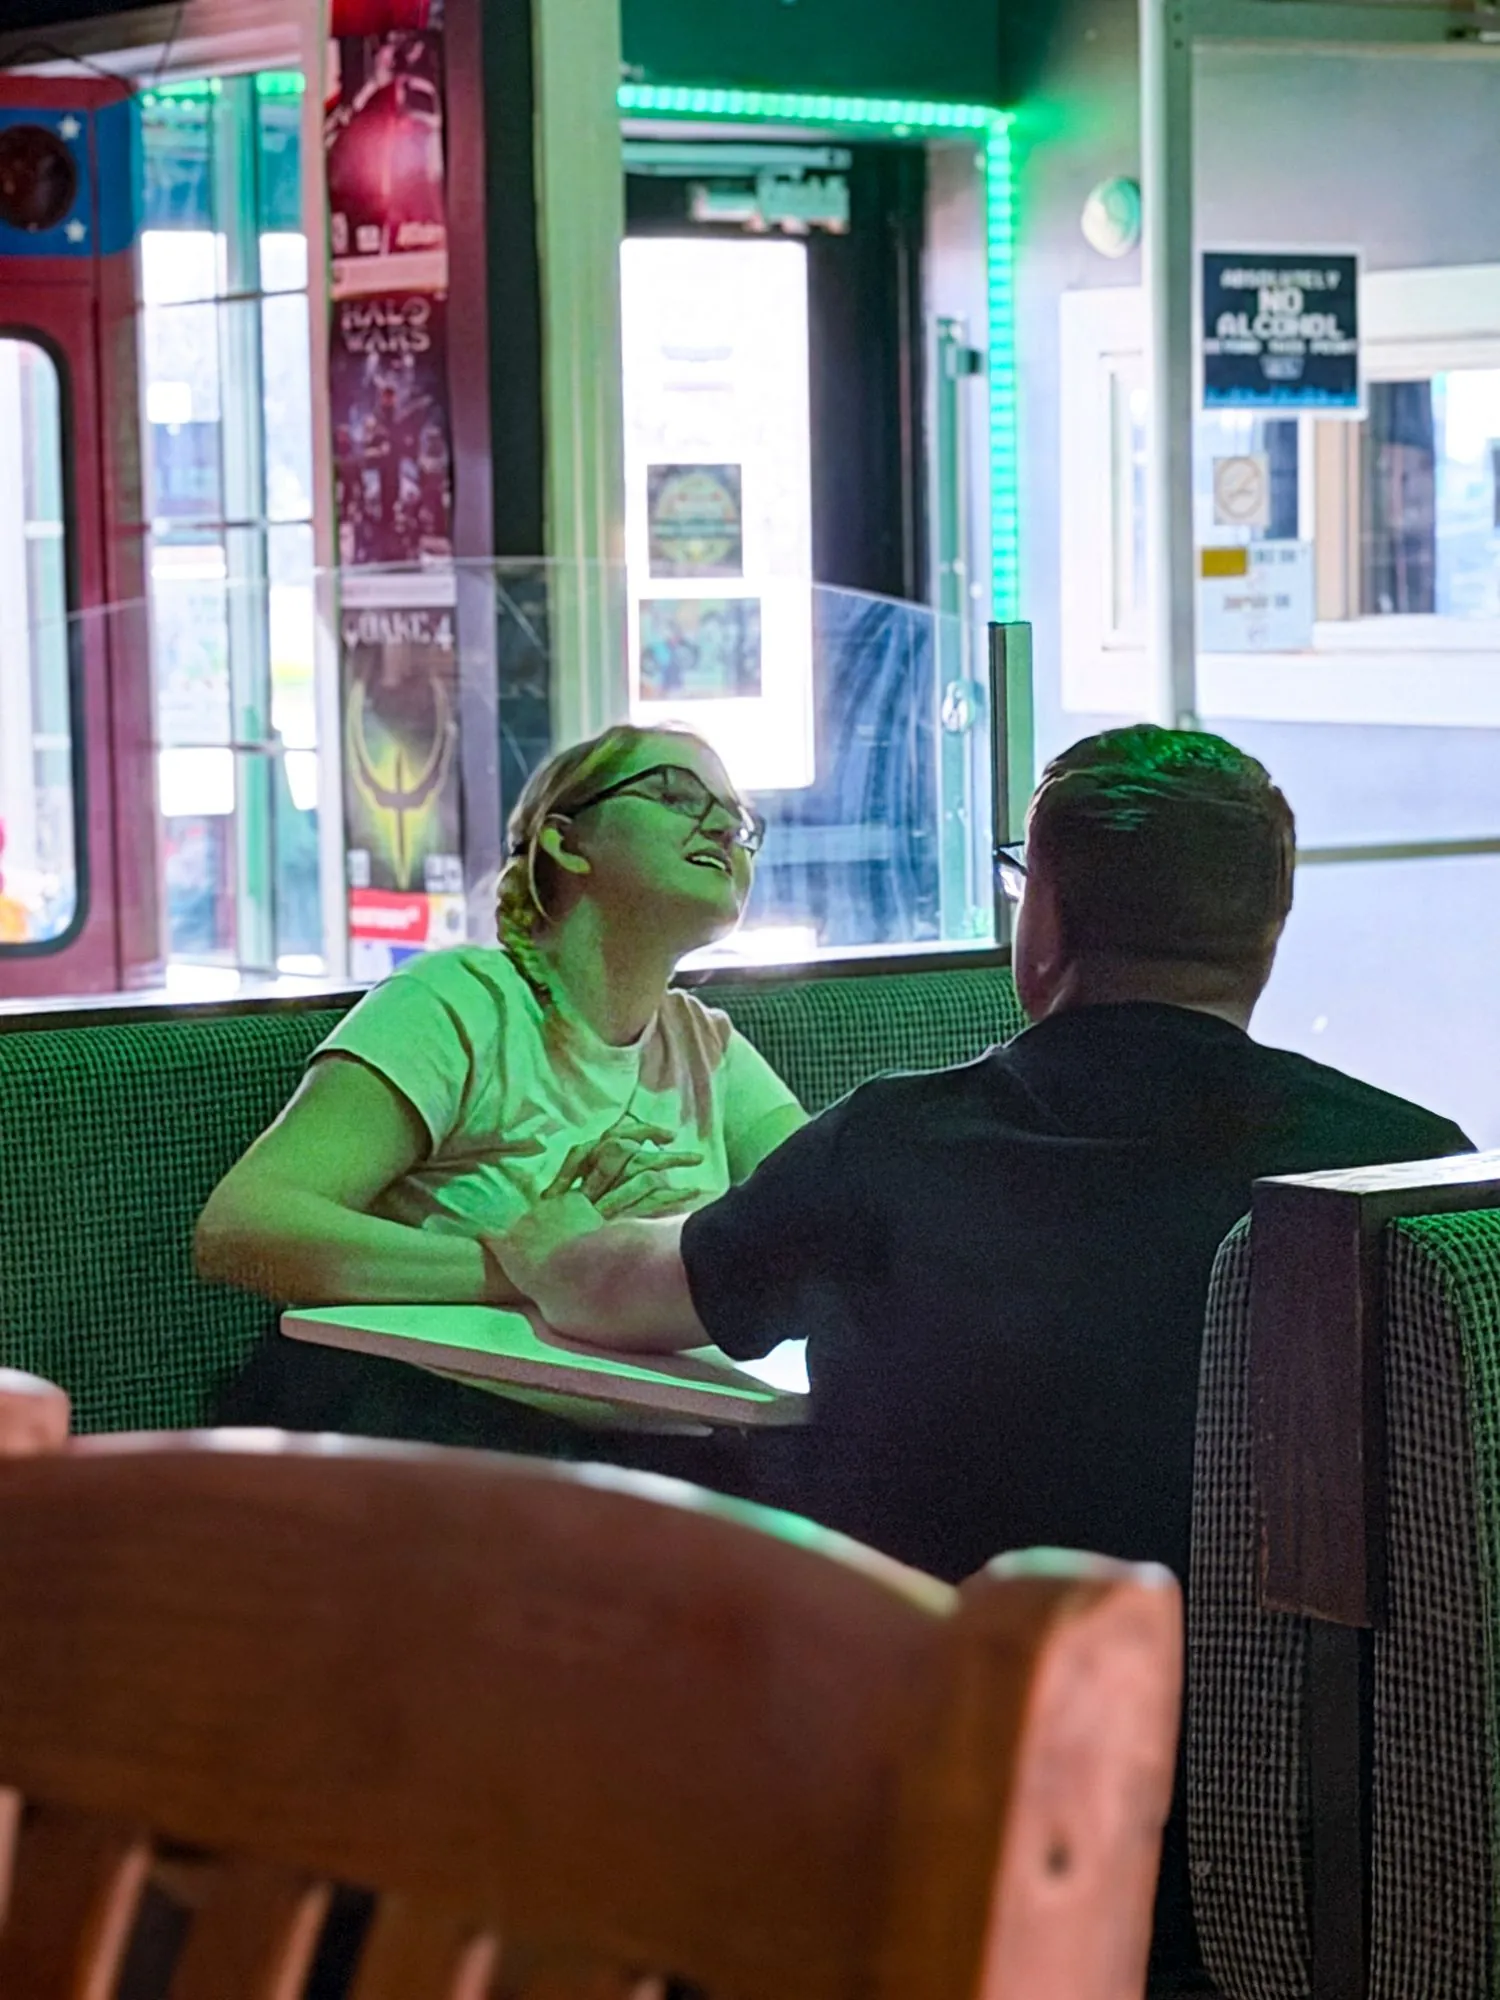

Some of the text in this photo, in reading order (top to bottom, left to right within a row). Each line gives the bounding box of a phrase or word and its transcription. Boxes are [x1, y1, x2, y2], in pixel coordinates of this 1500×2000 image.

[1219, 269, 1341, 290] ABSOLUTELY
[341, 298, 430, 329] HALO
[1257, 287, 1304, 318] NO
[343, 329, 430, 352] WARS
[1216, 312, 1345, 341] ALCOHOL
